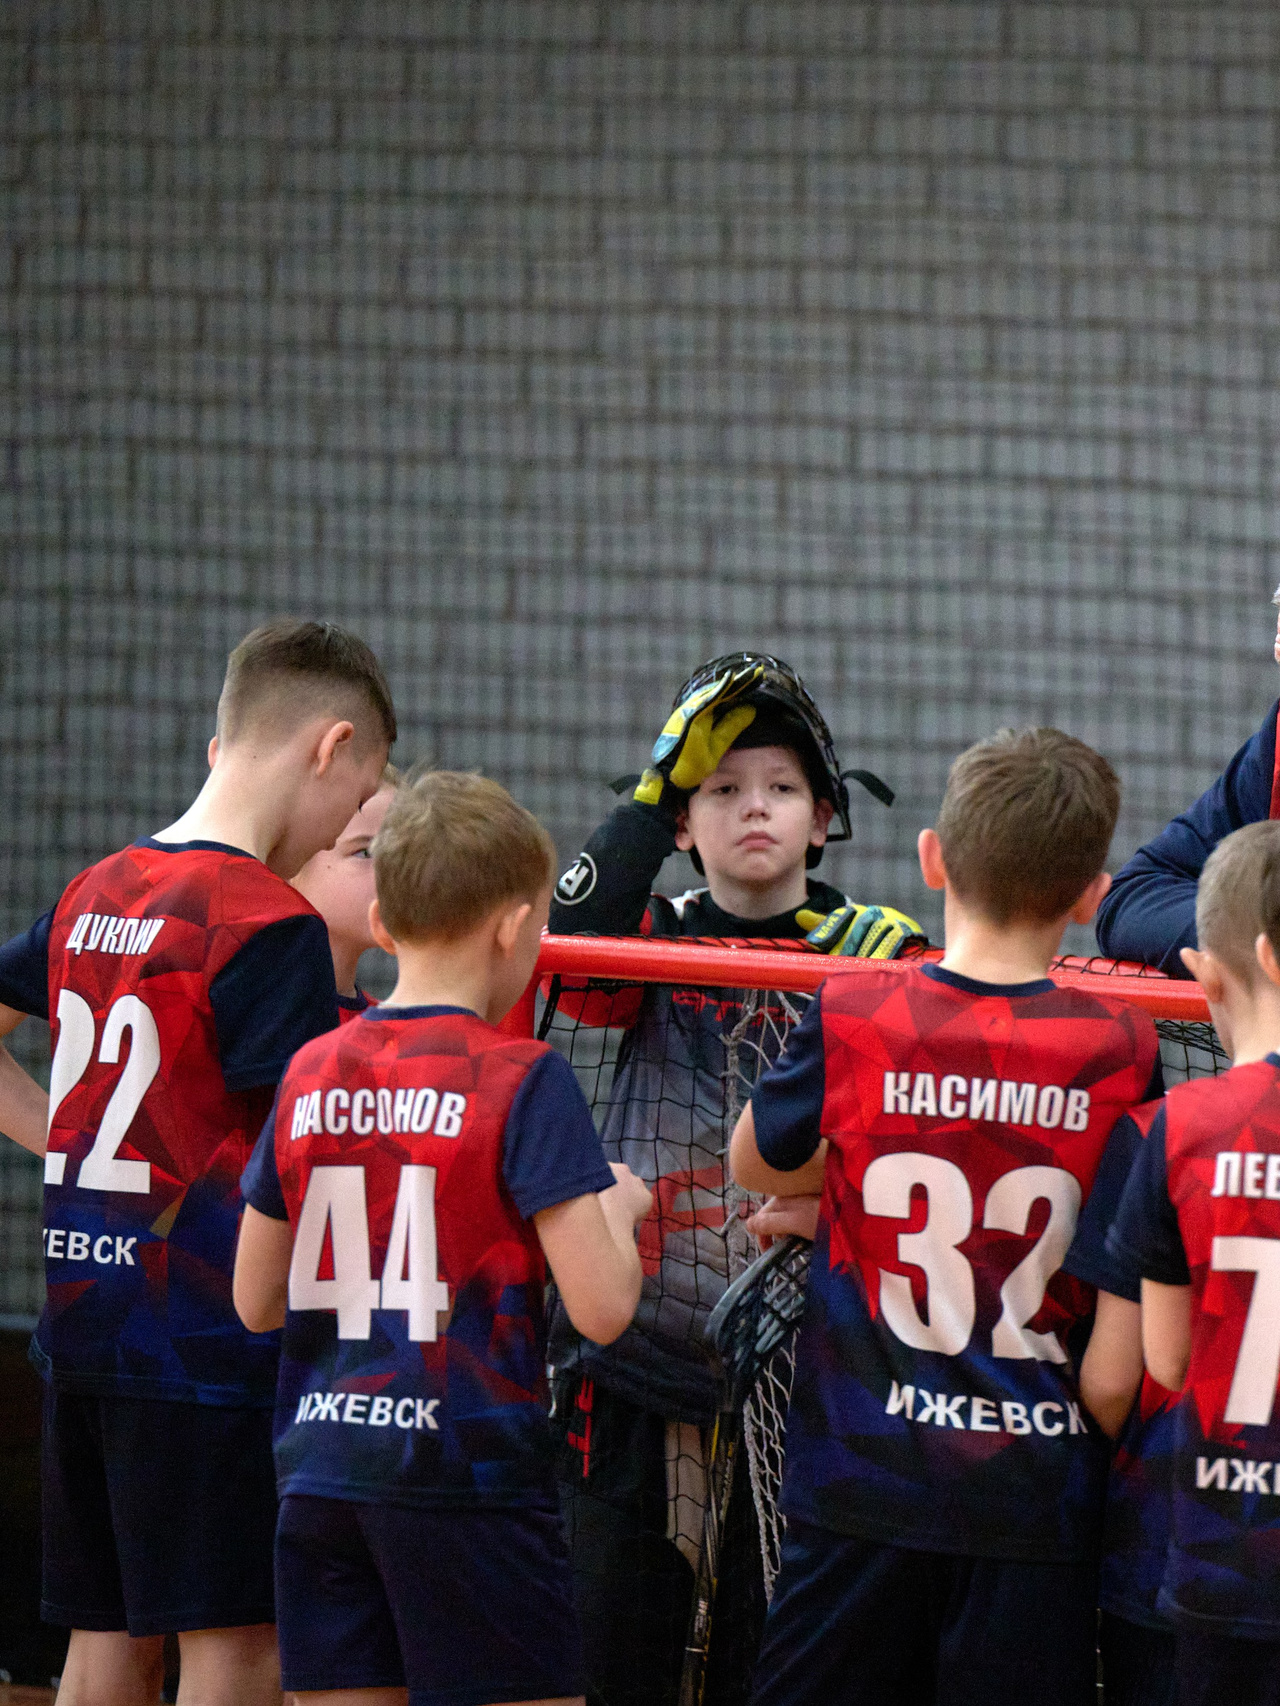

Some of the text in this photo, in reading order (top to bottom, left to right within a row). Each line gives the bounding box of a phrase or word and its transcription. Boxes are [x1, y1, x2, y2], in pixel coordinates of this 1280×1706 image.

[44, 988, 161, 1194] 22
[290, 1087, 467, 1141] НАССОНОВ
[883, 1071, 1090, 1132] КАСИМОВ
[288, 1164, 449, 1343] 44
[862, 1150, 1082, 1364] 32
[294, 1391, 440, 1430] ИЖЕВСК
[884, 1379, 1089, 1437] ИЖЕВСК
